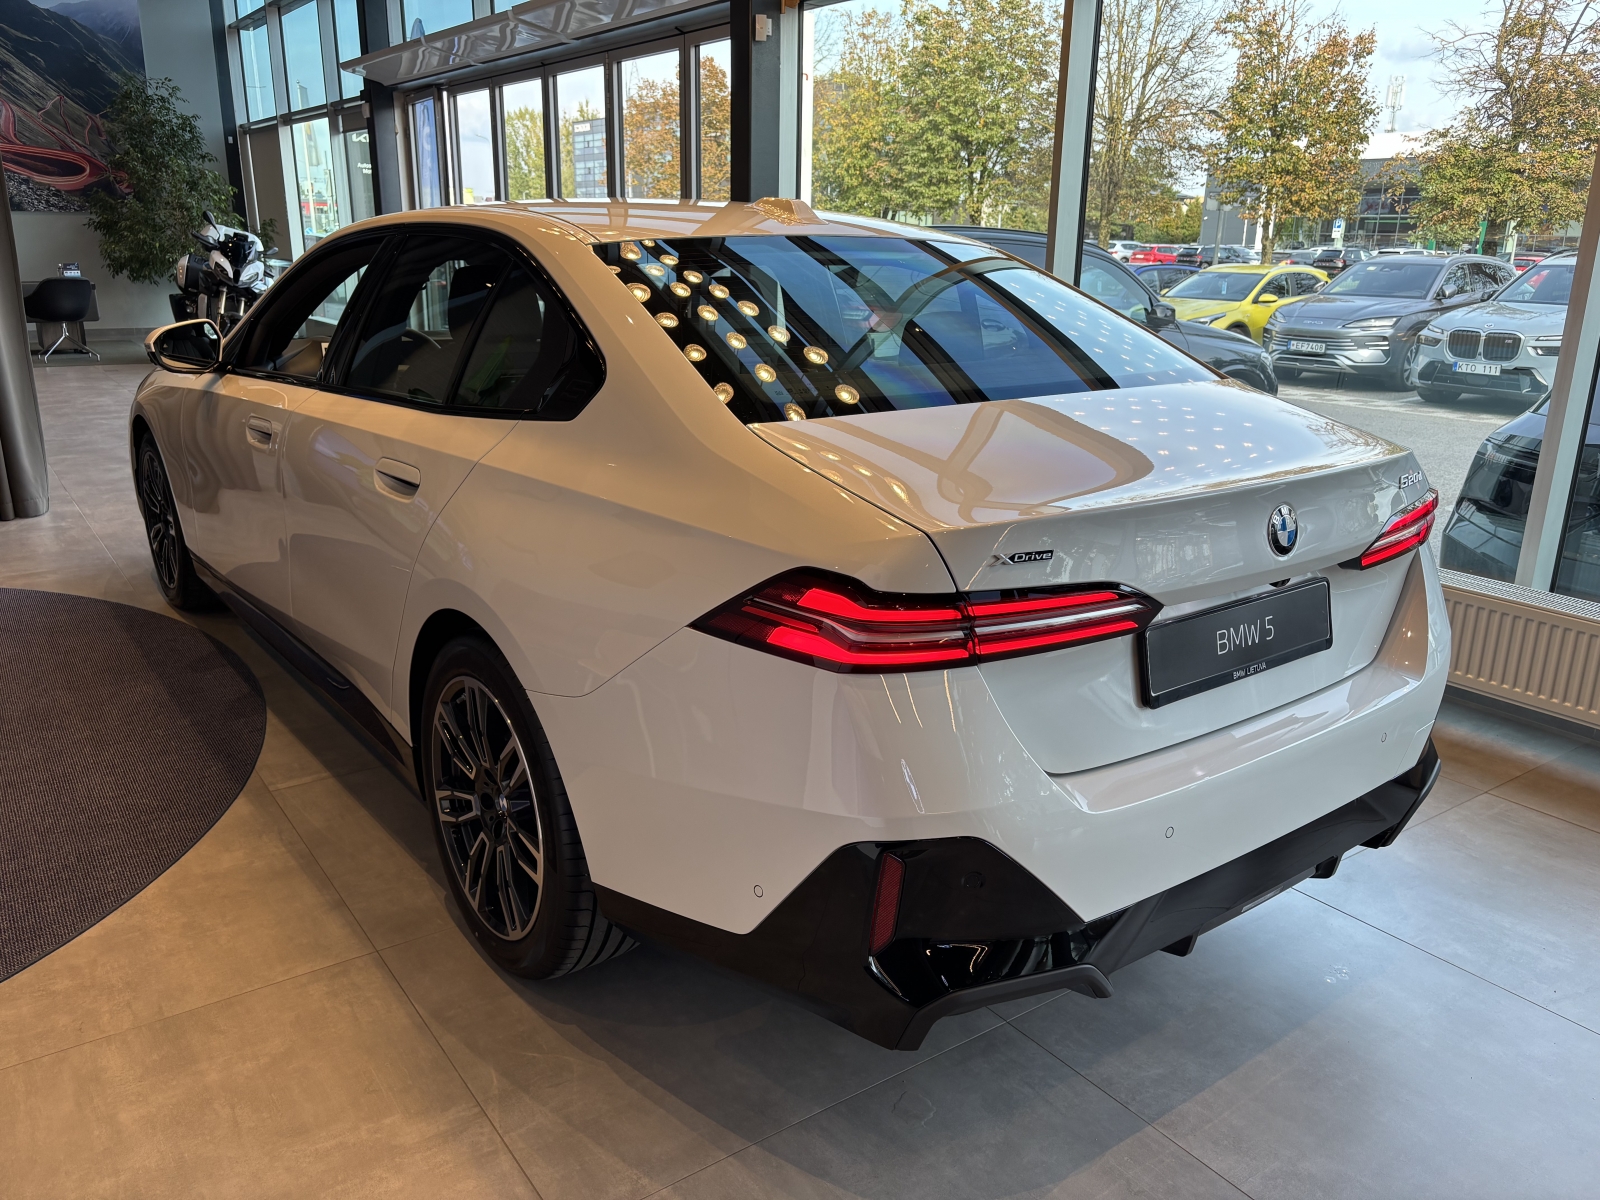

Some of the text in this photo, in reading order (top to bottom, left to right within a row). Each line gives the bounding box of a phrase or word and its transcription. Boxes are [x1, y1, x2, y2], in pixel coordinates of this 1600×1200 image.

[1457, 363, 1498, 374] KTO 111
[1216, 615, 1275, 655] BMW 5
[1233, 662, 1267, 680] BMW LIETUVA
